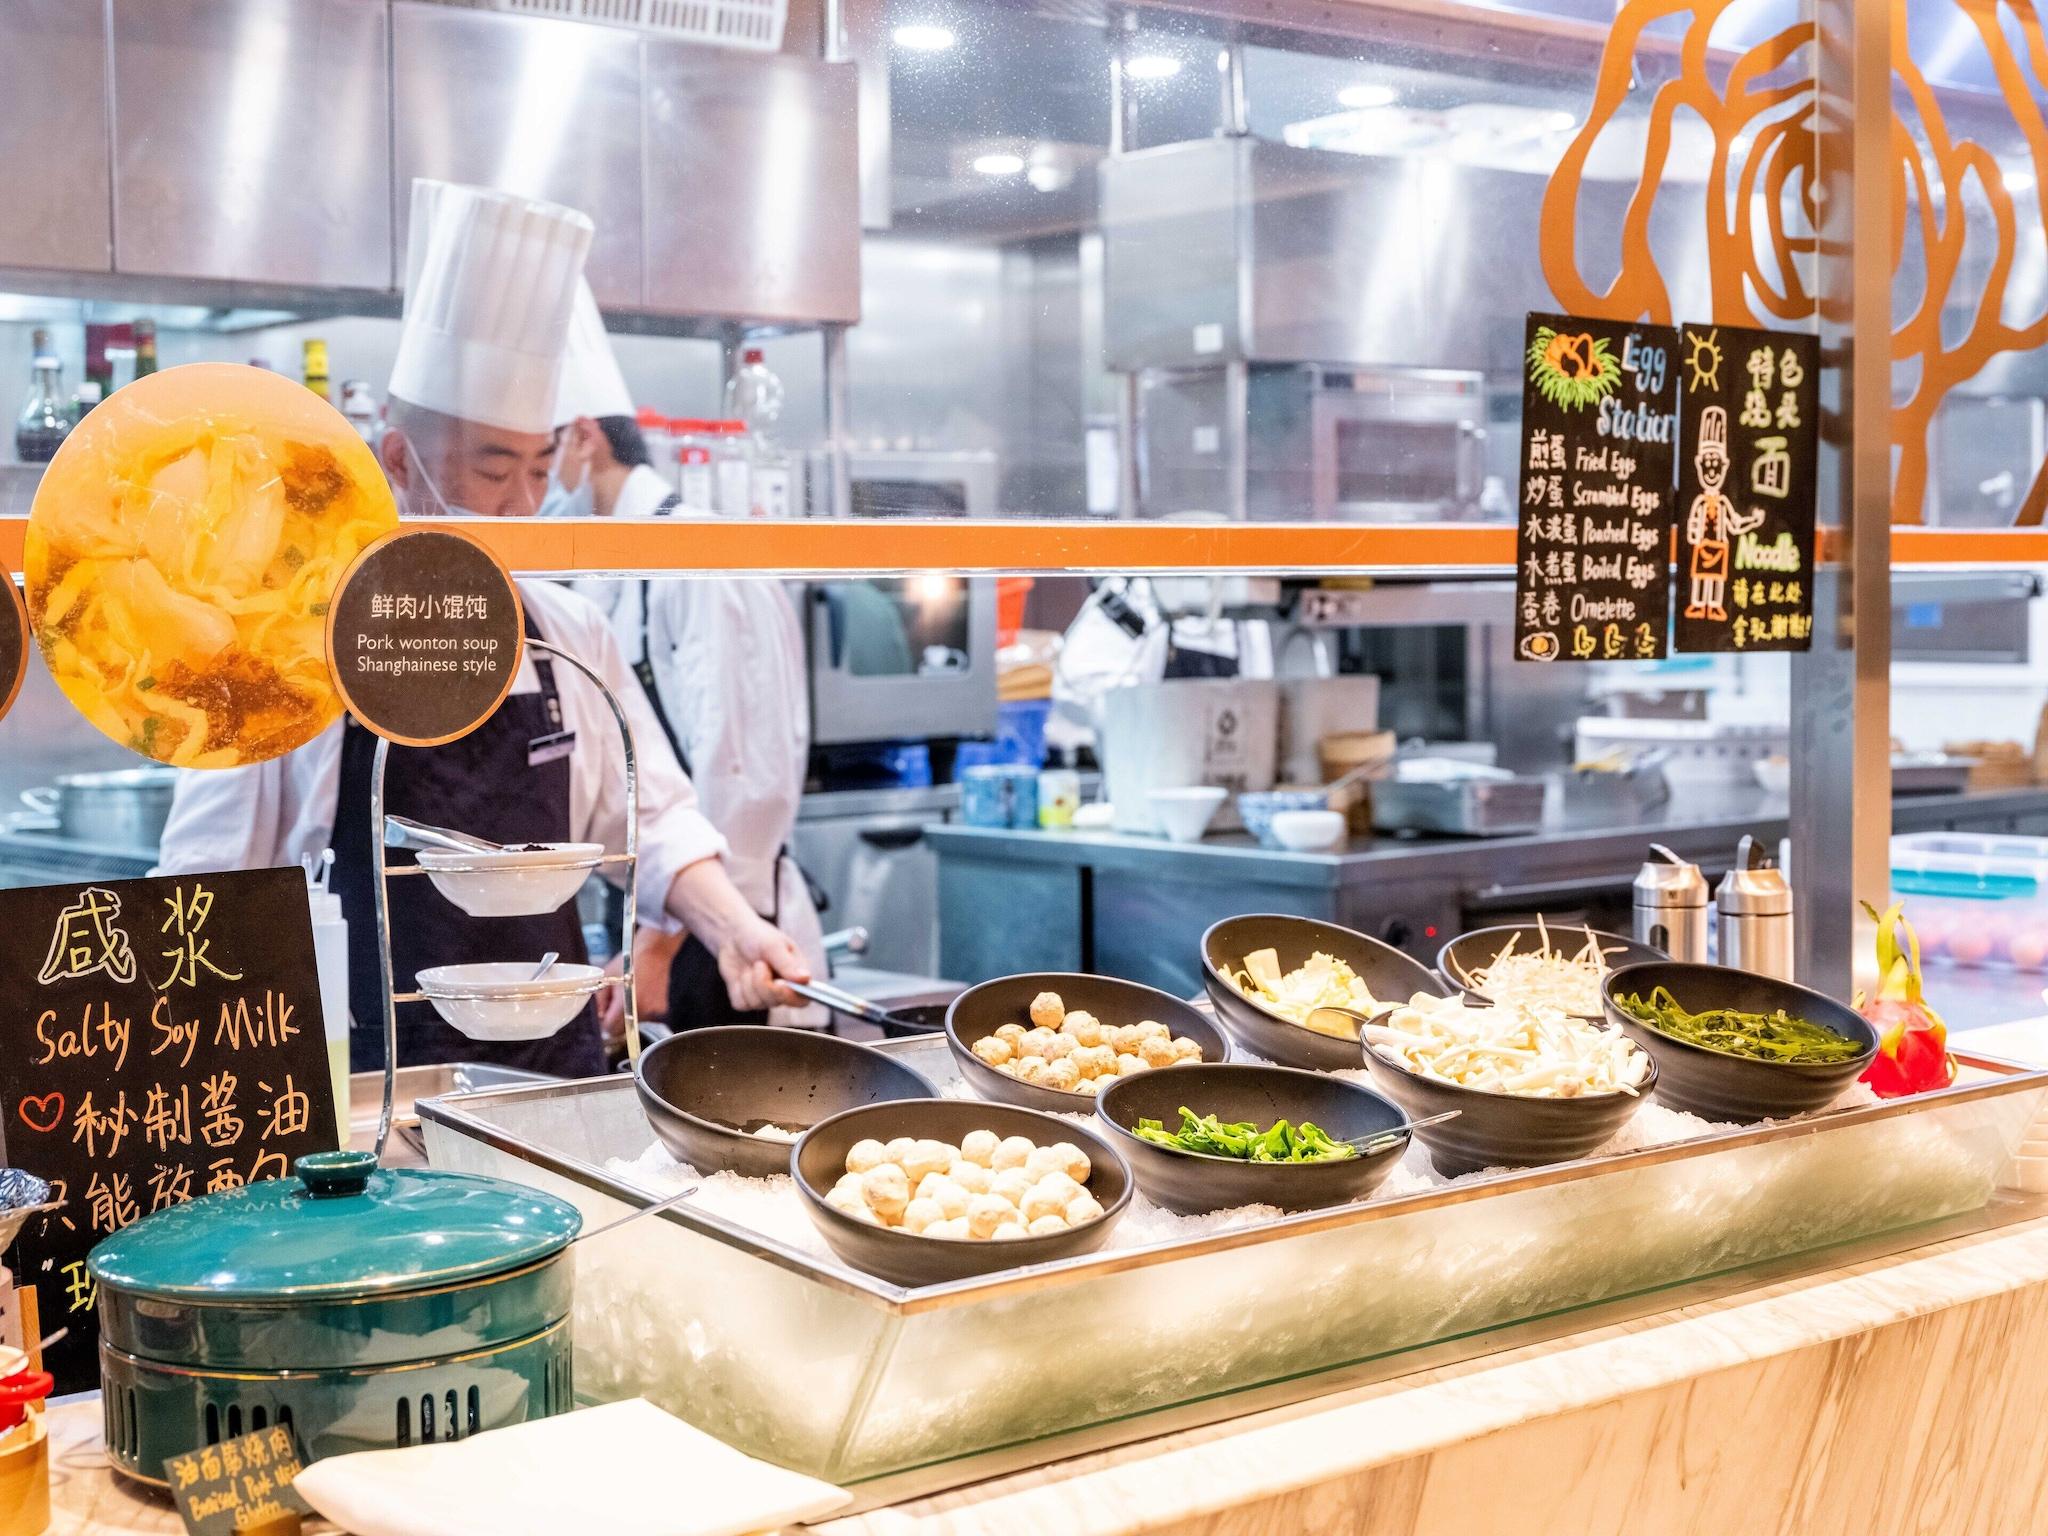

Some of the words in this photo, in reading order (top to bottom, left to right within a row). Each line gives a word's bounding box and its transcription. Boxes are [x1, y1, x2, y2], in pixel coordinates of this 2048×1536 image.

[1621, 332, 1667, 395] Egg
[1529, 428, 1567, 471] 煎蛋
[1575, 446, 1608, 472] Fried
[1610, 450, 1637, 480] Eggs
[1524, 475, 1564, 509] 炒蛋
[1631, 485, 1660, 516] Eggs
[1582, 516, 1629, 546] Poached
[1630, 521, 1659, 551] Eggs
[1734, 531, 1801, 573] Noodle
[1524, 551, 1577, 588] 水煮蛋
[1582, 553, 1622, 581] Boiled
[1625, 556, 1657, 589] Eggs
[371, 593, 488, 620] 鲜肉小馄饨
[1521, 588, 1562, 628] 蛋卷
[1570, 593, 1636, 622] Omelette
[357, 633, 394, 650] Pork
[399, 635, 458, 650] wonton
[462, 638, 498, 654] soup
[357, 656, 458, 676] Shanghainese
[462, 656, 497, 676] style
[36, 1001, 131, 1072] Salty
[151, 996, 199, 1068] Soy
[215, 989, 301, 1051] Milk
[73, 1070, 310, 1158] 秘制酱油
